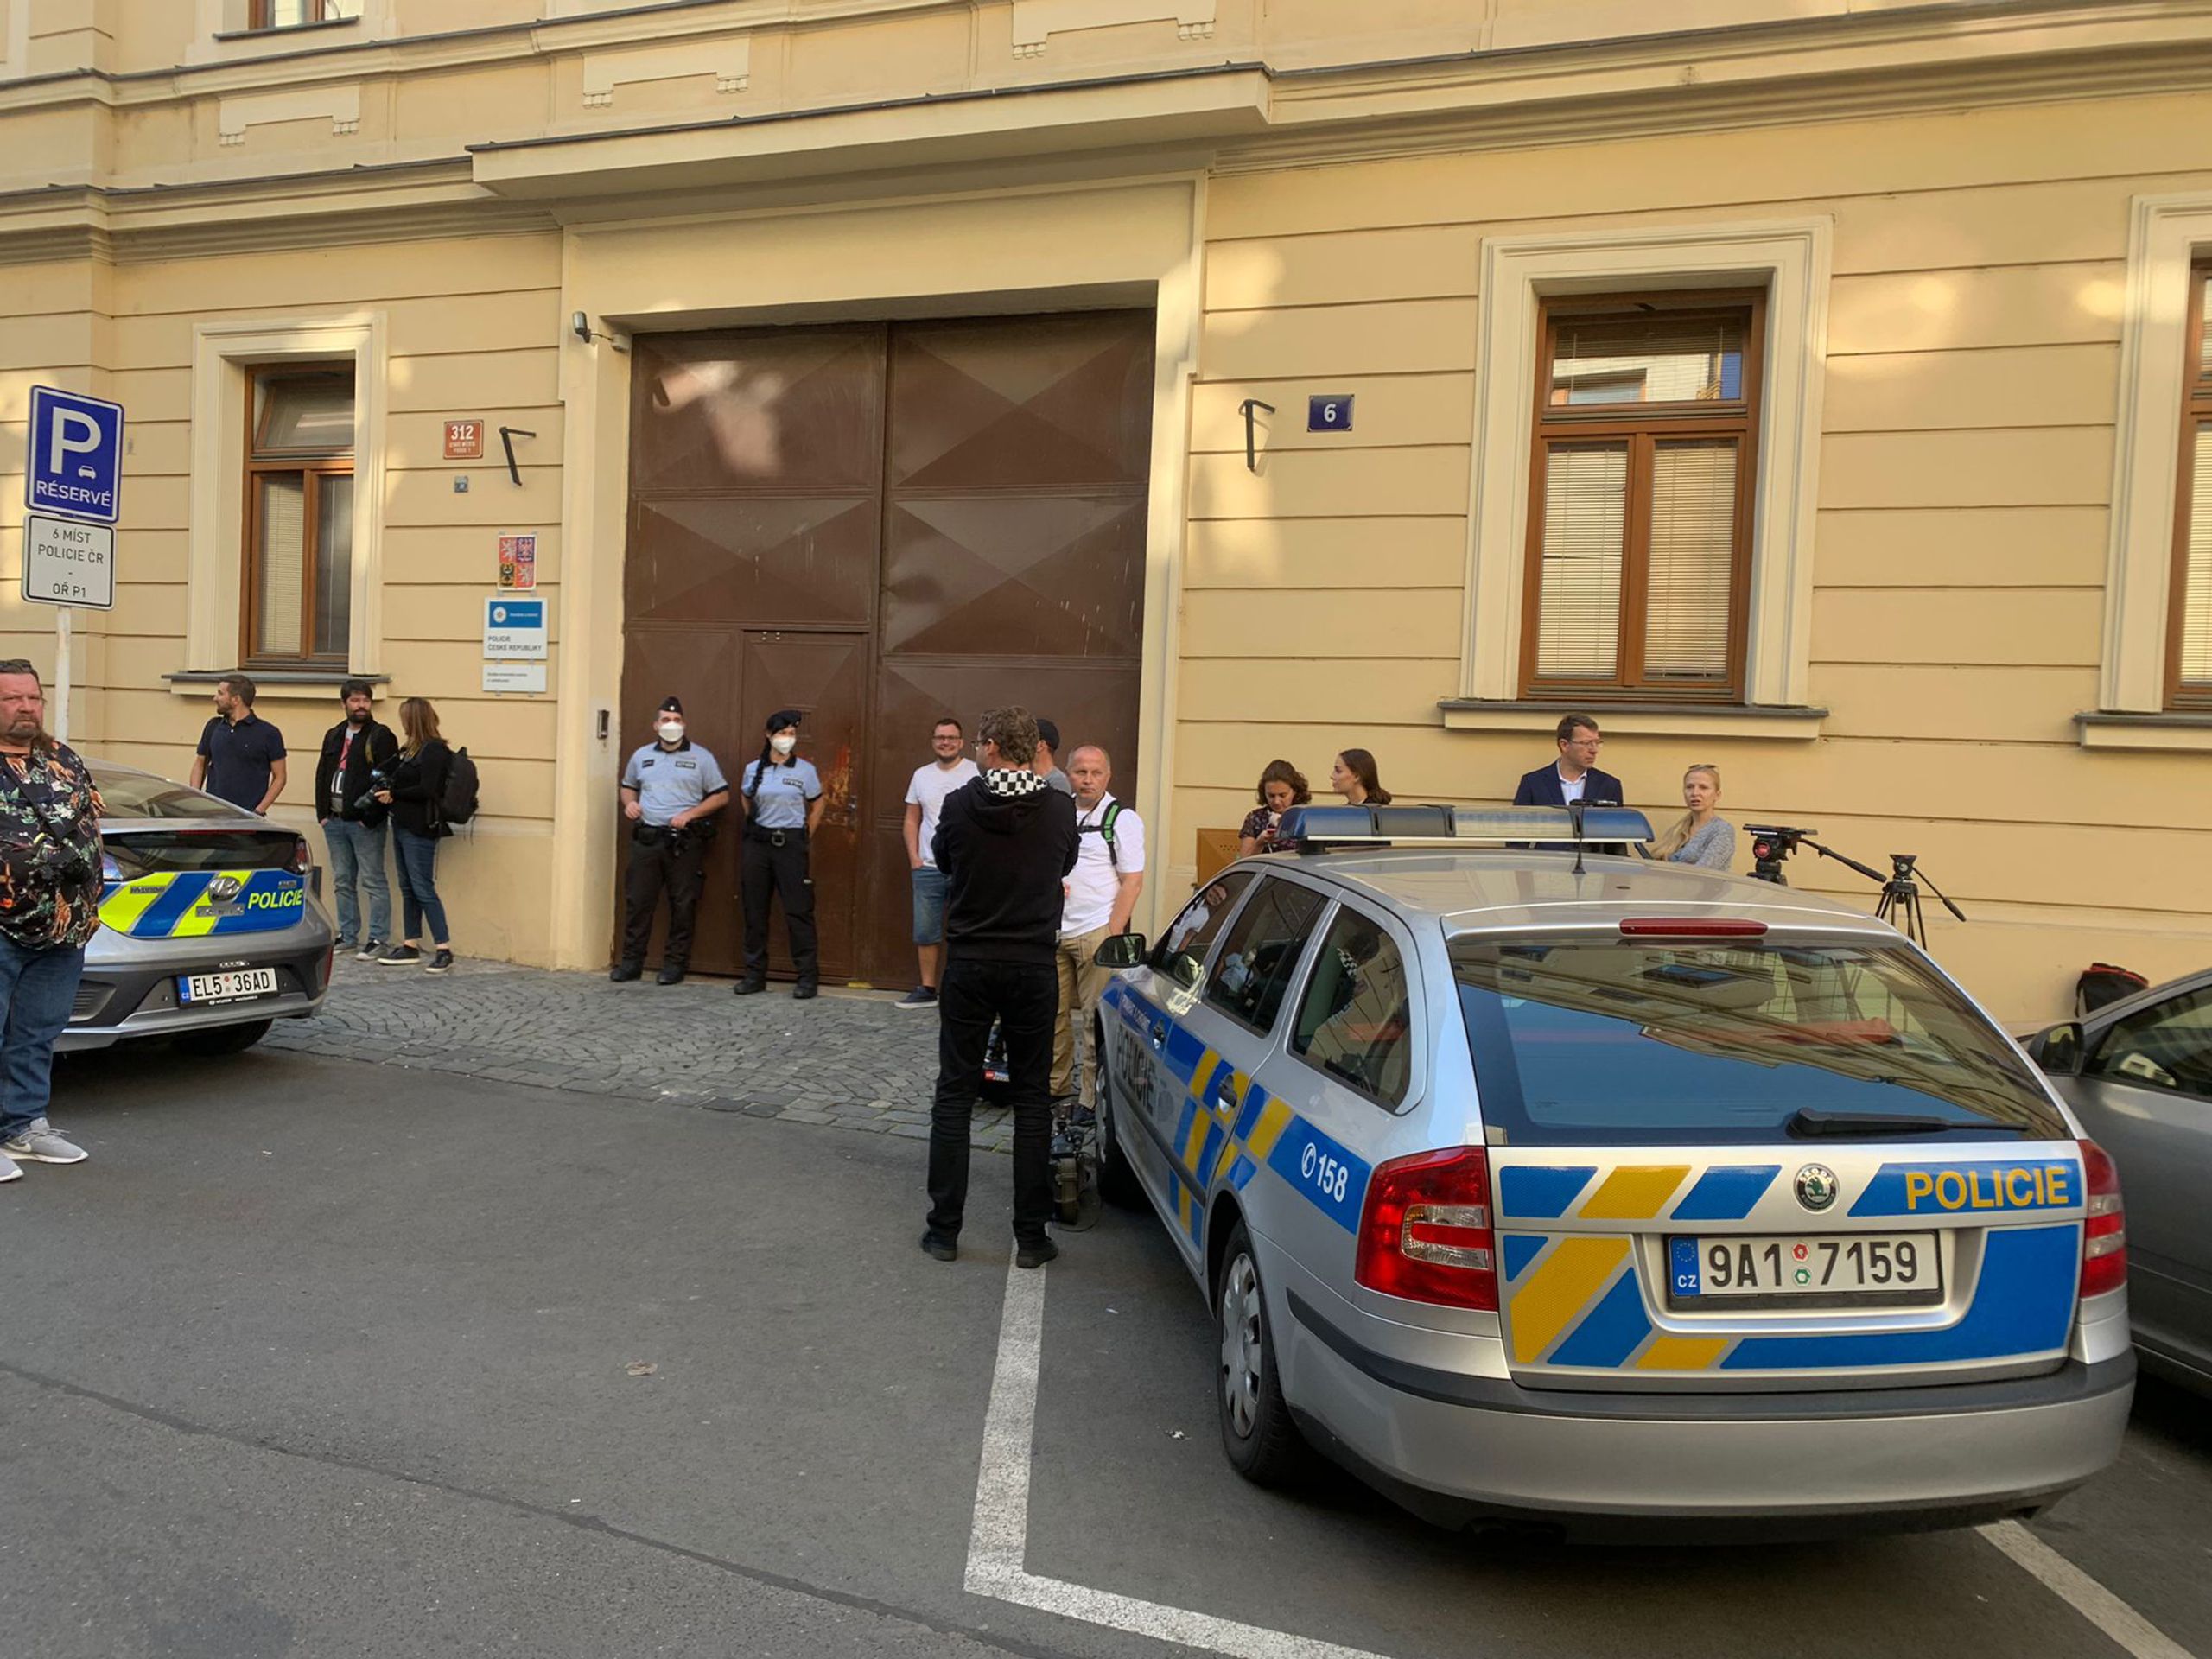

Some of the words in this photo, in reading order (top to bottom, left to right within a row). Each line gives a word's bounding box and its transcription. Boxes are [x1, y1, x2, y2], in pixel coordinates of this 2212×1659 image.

[1324, 403, 1337, 423] 6
[49, 406, 102, 474] P
[450, 424, 474, 441] 312
[35, 480, 111, 507] RÉSERVÉ
[53, 528, 60, 539] 6
[62, 527, 91, 543] MÍST
[37, 543, 85, 562] POLICIE
[87, 549, 104, 564] ČR
[73, 585, 86, 597] P1
[247, 889, 303, 909] POLICIE
[192, 976, 222, 997] EL5
[233, 971, 270, 993] 36AD
[1317, 1153, 1348, 1203] 158
[1905, 1166, 2069, 1210] POLICIE
[1708, 1243, 1782, 1287] 9A1
[1817, 1240, 1917, 1286] 7159
[1677, 1274, 1697, 1288] CZ
